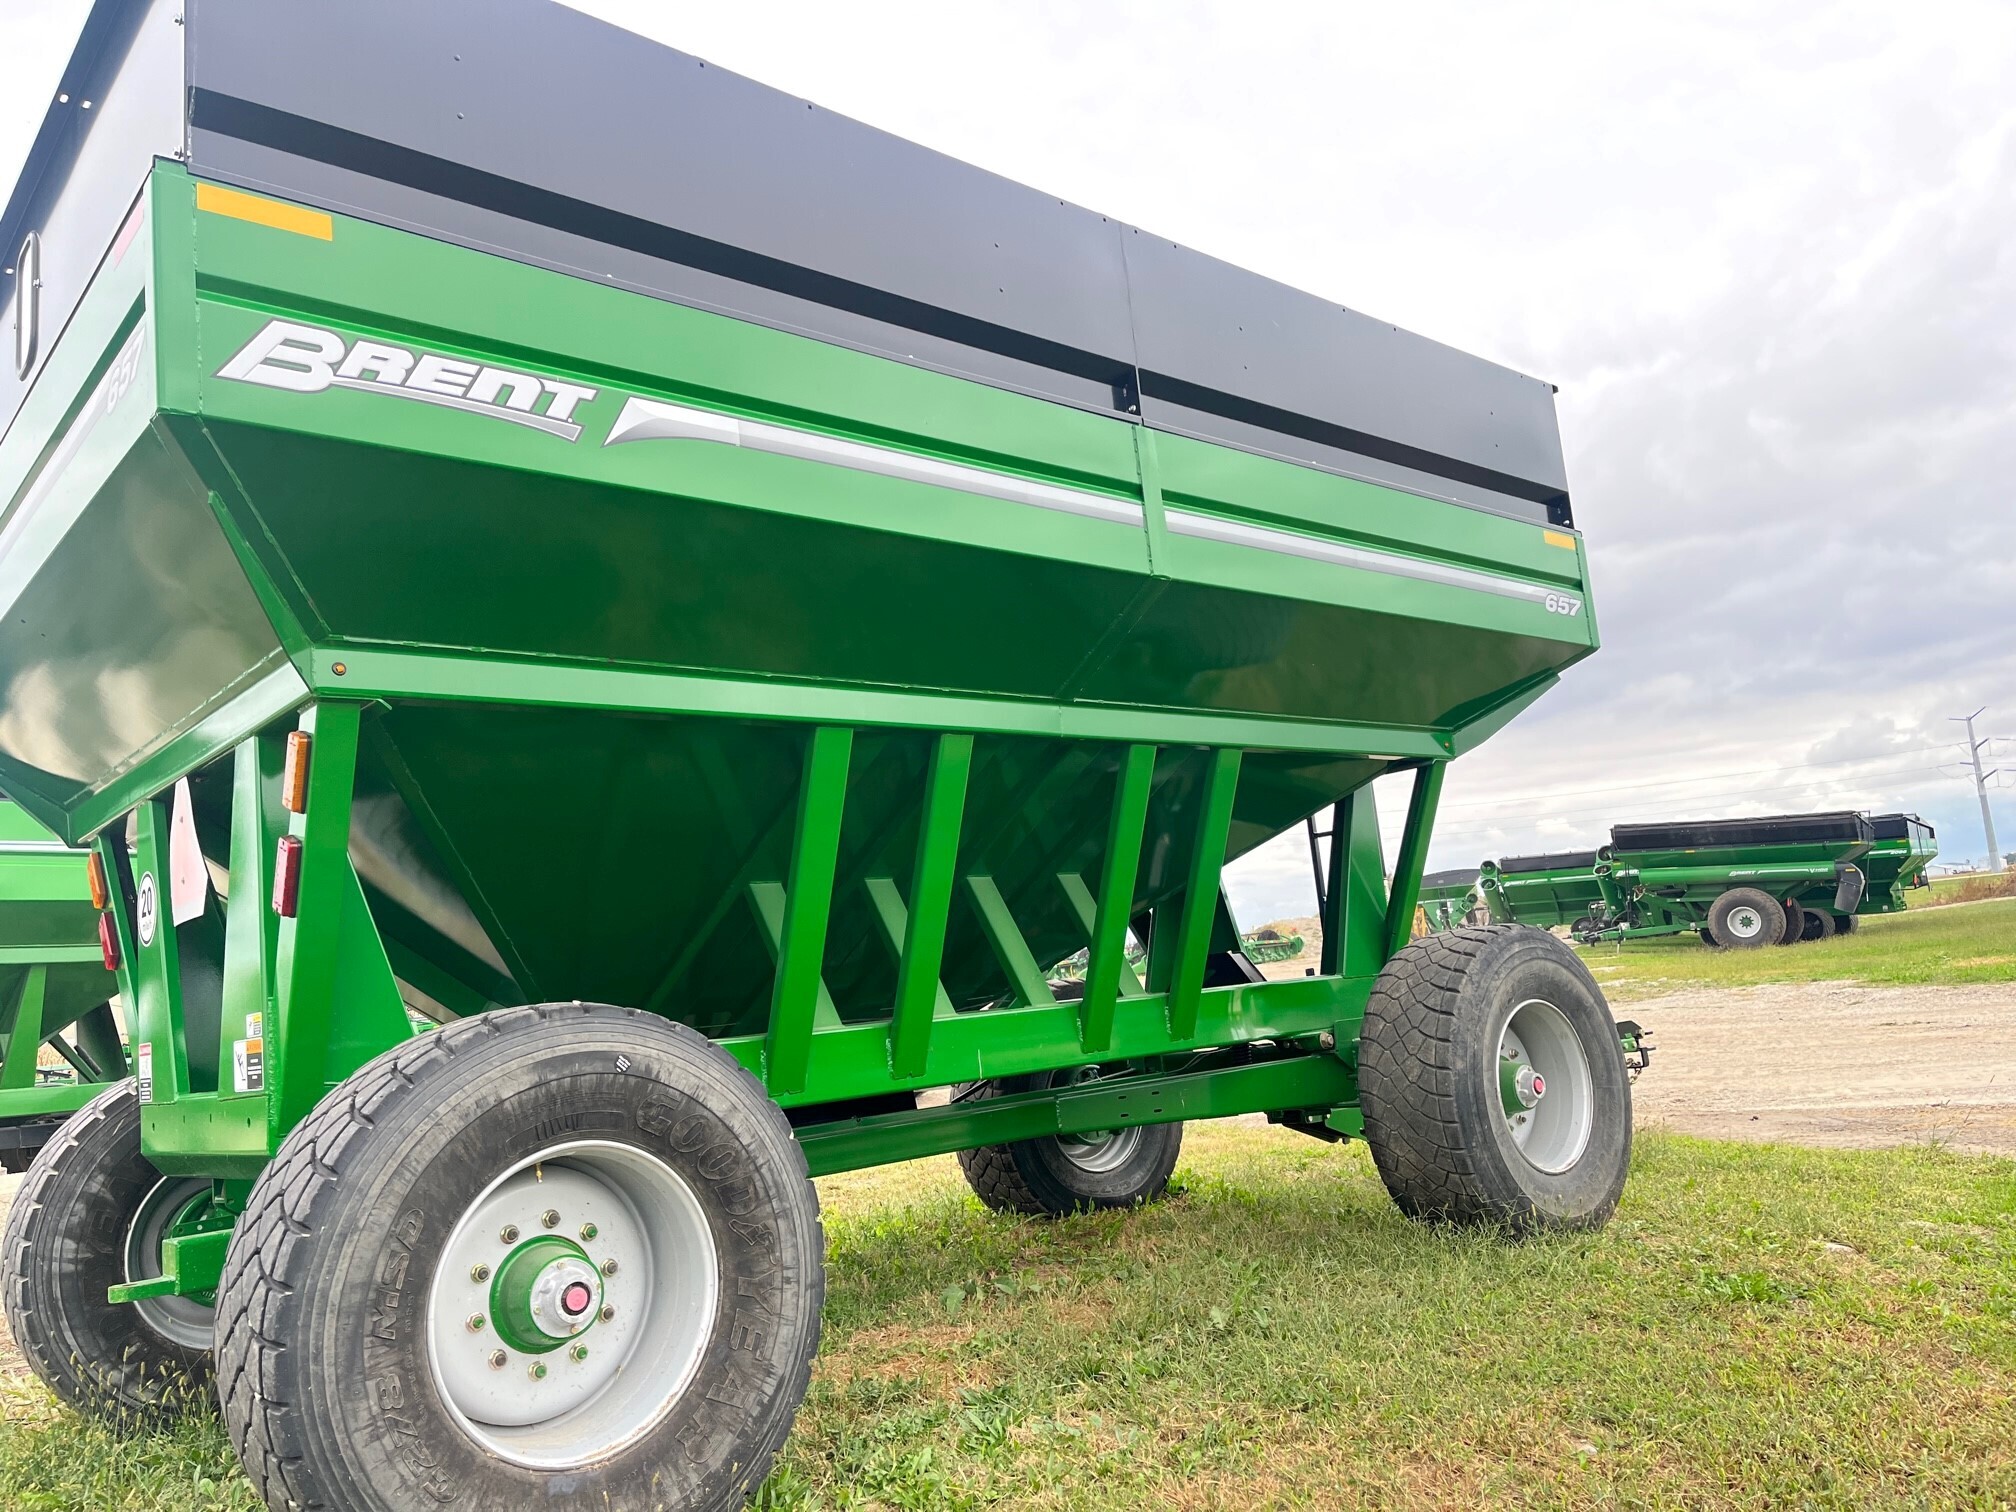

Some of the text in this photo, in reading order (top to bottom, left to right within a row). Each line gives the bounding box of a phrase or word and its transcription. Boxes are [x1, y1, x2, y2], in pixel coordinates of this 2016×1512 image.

[106, 326, 146, 415] 657
[214, 319, 599, 441] BRENT
[1545, 594, 1582, 617] 657
[141, 886, 153, 919] 20
[372, 1207, 425, 1341] MSD
[635, 1092, 777, 1464] GOODYEAR
[374, 1373, 458, 1504] G278
